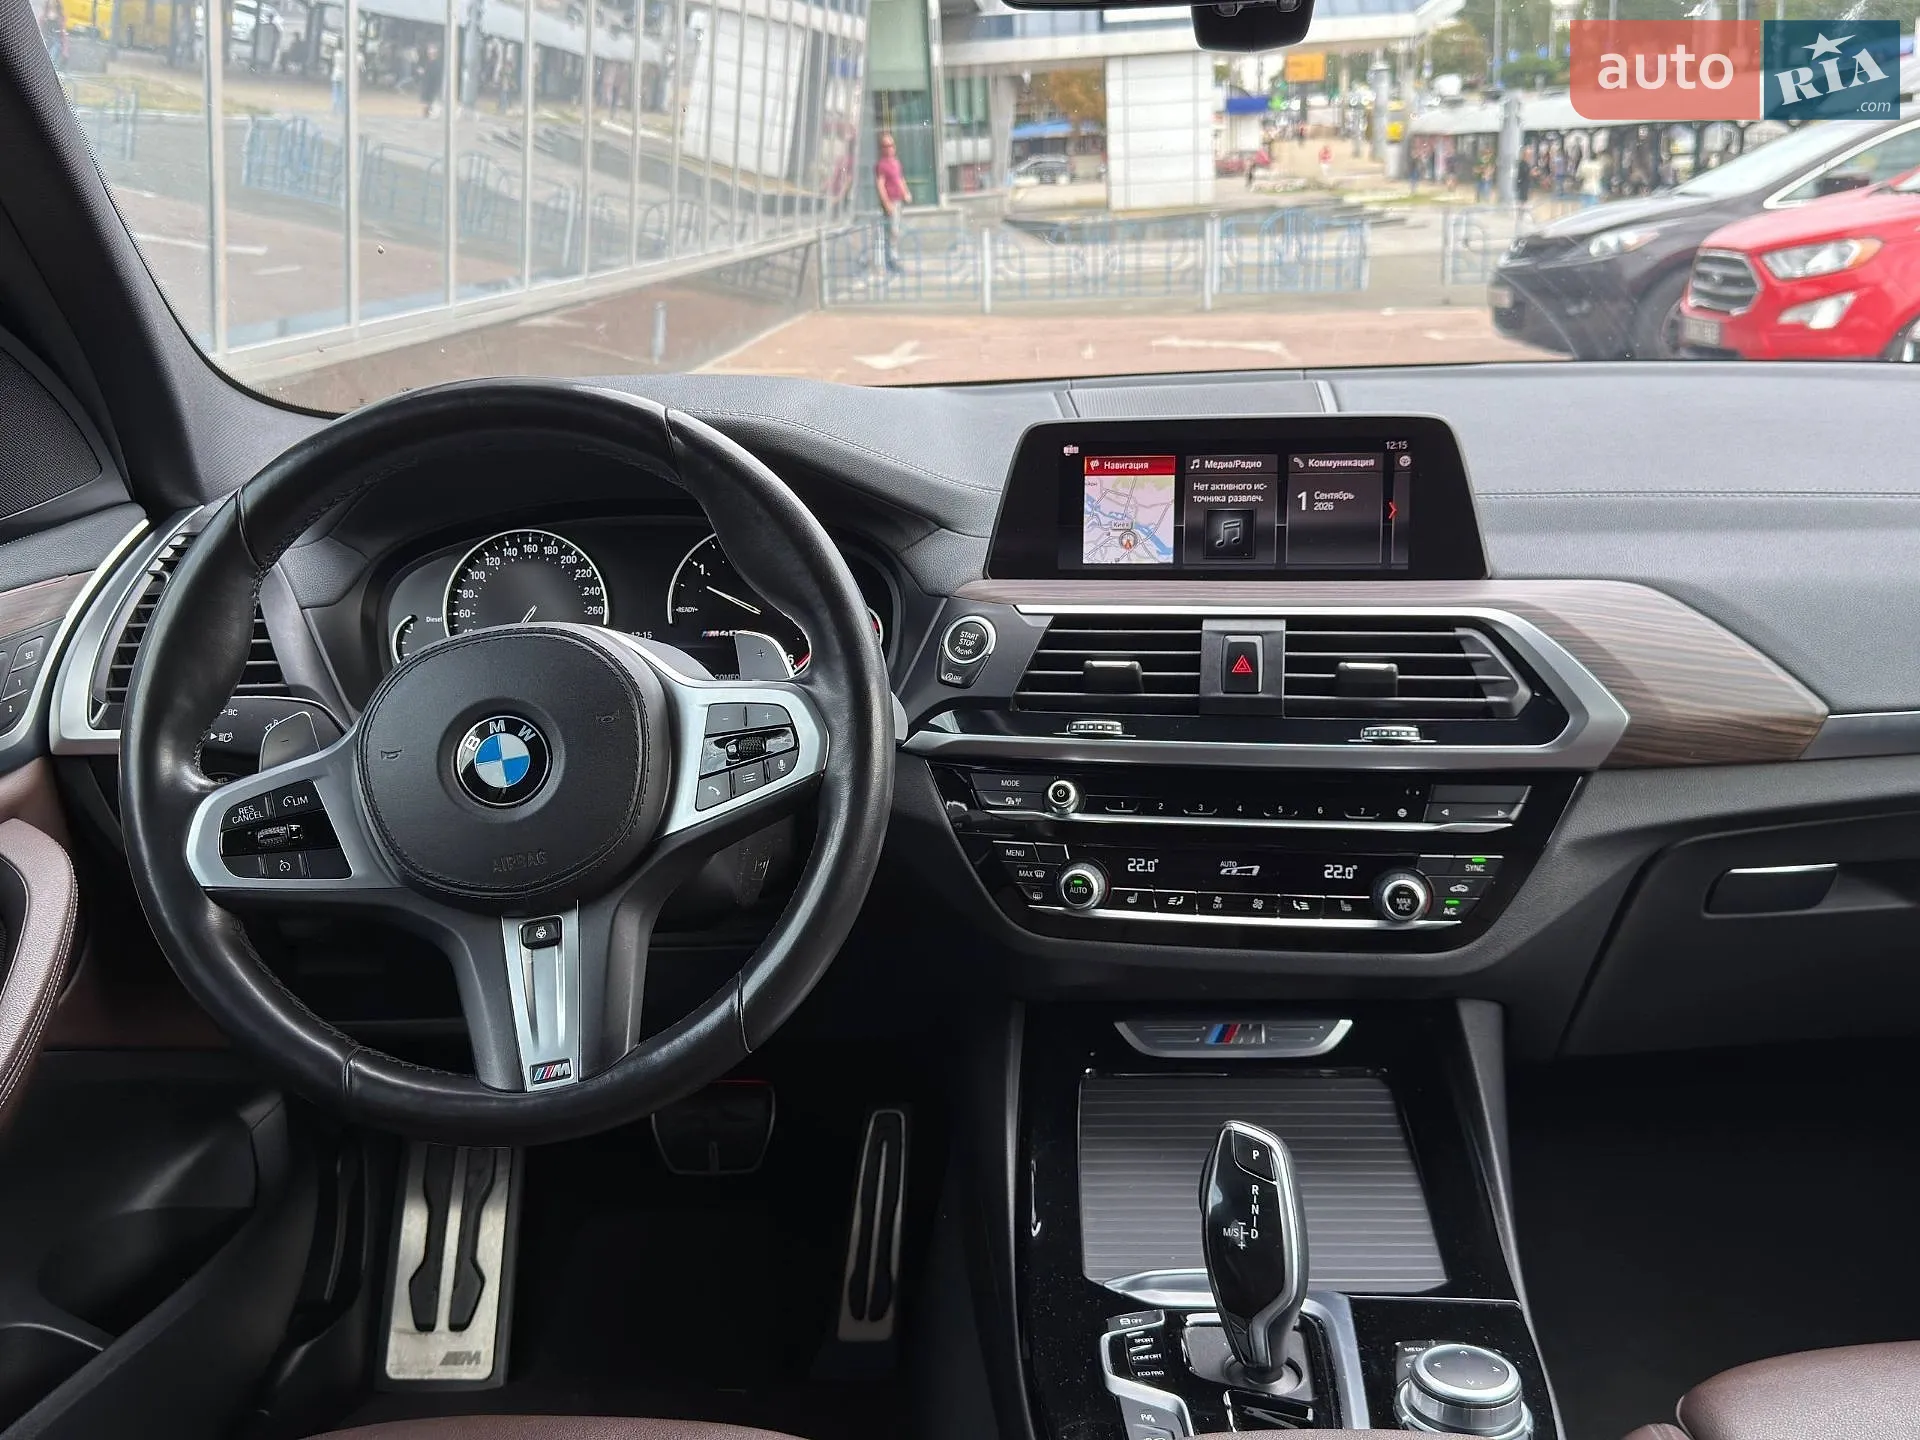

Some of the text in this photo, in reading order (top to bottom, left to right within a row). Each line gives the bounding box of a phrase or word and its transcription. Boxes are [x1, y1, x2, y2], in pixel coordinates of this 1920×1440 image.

[1386, 440, 1408, 450] 12:15
[1104, 461, 1149, 470] Навигация
[1204, 459, 1262, 469] Медиа/Радио
[1308, 458, 1375, 468] Коммуникация
[1193, 482, 1268, 491] Нет активного ис-
[1193, 494, 1264, 503] точника развлеч.
[1314, 491, 1355, 500] Сентябрь
[1297, 492, 1307, 510] 1
[1313, 502, 1334, 511] 2026
[502, 547, 518, 557] 140
[523, 544, 538, 554] 160
[544, 546, 559, 555] 180
[486, 557, 500, 566] 120
[560, 555, 577, 565] 200
[698, 563, 705, 575] 1
[470, 571, 486, 580] 100
[575, 569, 592, 579] 220
[462, 589, 474, 599] 80
[584, 587, 601, 596] 240
[459, 609, 471, 619] 60
[587, 606, 604, 615] 260
[960, 631, 979, 641] START
[958, 638, 976, 647] STOP
[465, 719, 536, 751] BMW
[1000, 779, 1020, 787] MODE
[292, 795, 309, 806] LIM
[1119, 801, 1125, 809] 1
[238, 805, 254, 816] RES
[1158, 802, 1164, 810] 2
[1198, 803, 1204, 811] 3
[232, 810, 265, 825] CANCEL
[1005, 849, 1025, 857] MENU
[1219, 860, 1238, 868] AUTO
[1465, 863, 1486, 872] SYNC
[1018, 869, 1034, 878] MAX
[1069, 886, 1088, 895] AUTO
[1252, 1149, 1260, 1160] P
[1251, 1184, 1260, 1196] R
[1251, 1204, 1260, 1215] N
[1250, 1228, 1259, 1240] D
[1132, 1353, 1162, 1361] COMFORT
